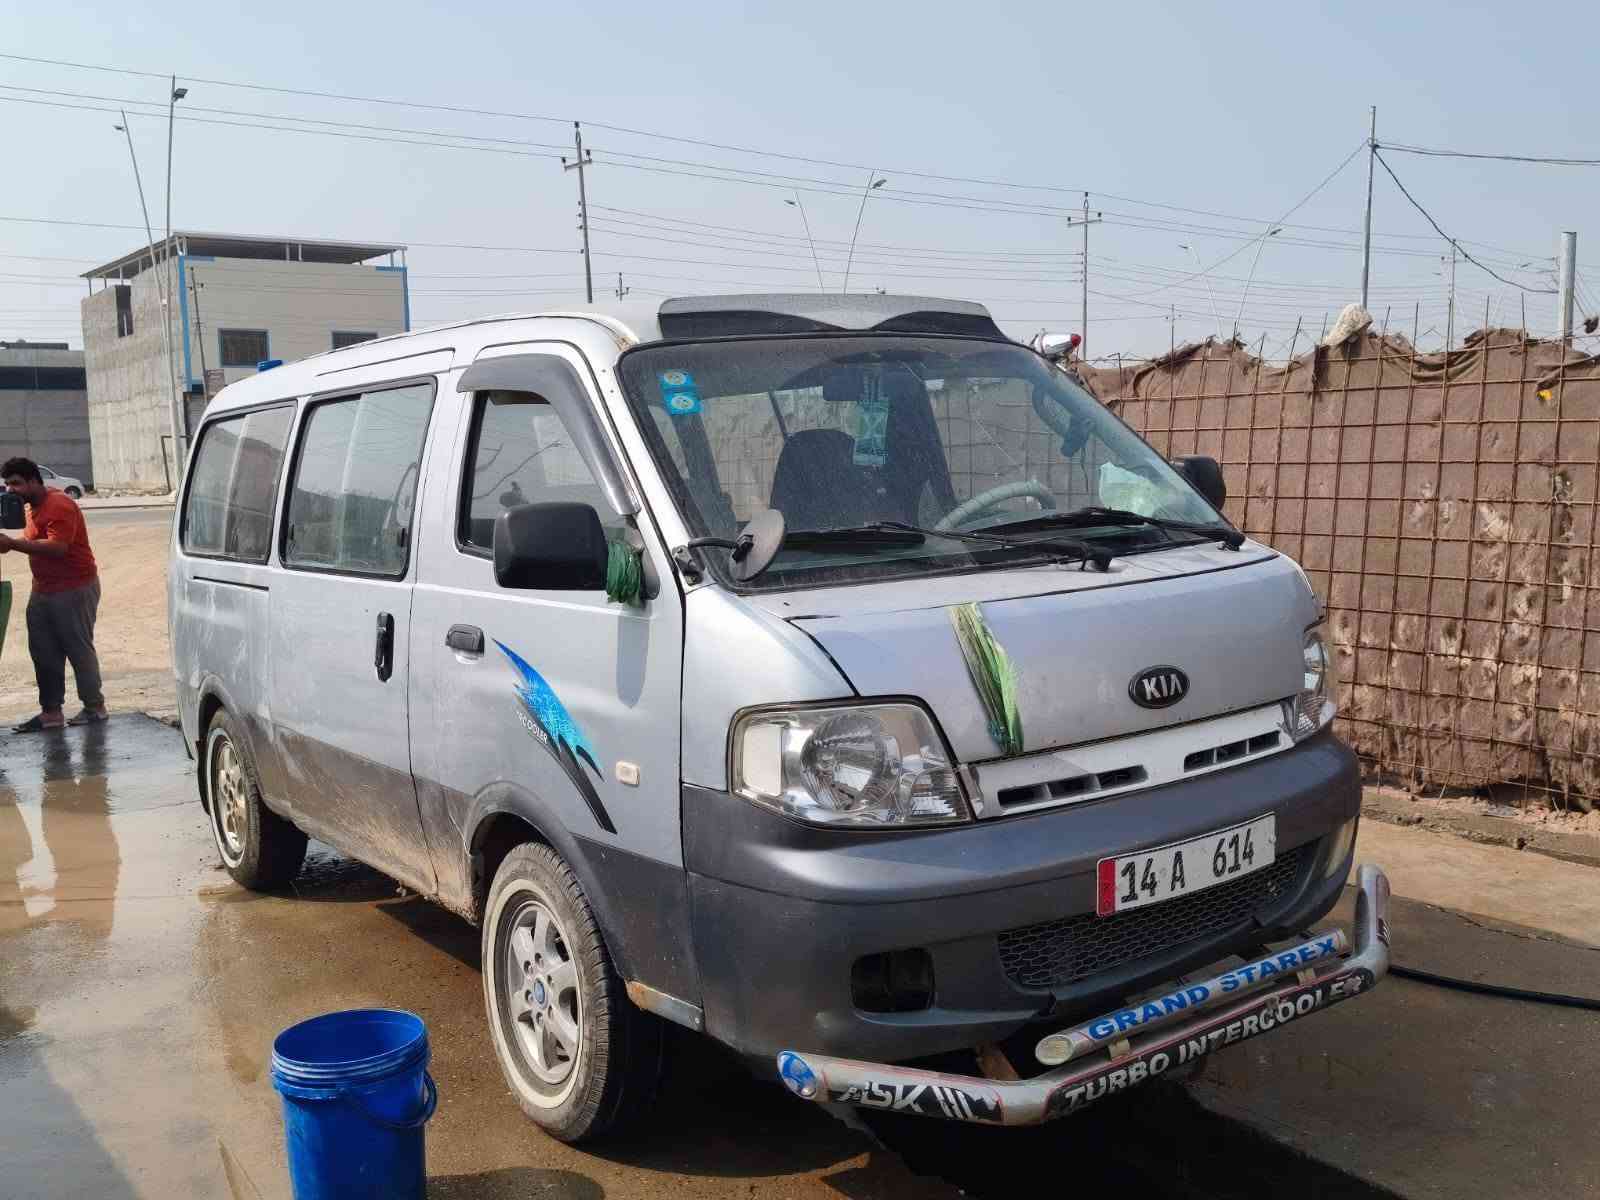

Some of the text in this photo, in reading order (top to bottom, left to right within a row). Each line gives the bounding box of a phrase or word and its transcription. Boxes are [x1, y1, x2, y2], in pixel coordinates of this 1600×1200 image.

[1142, 674, 1183, 700] KIA
[1121, 828, 1254, 904] 14 A 614
[1088, 938, 1335, 1040] GRAND STAREX
[1065, 1052, 1171, 1109] TURBO
